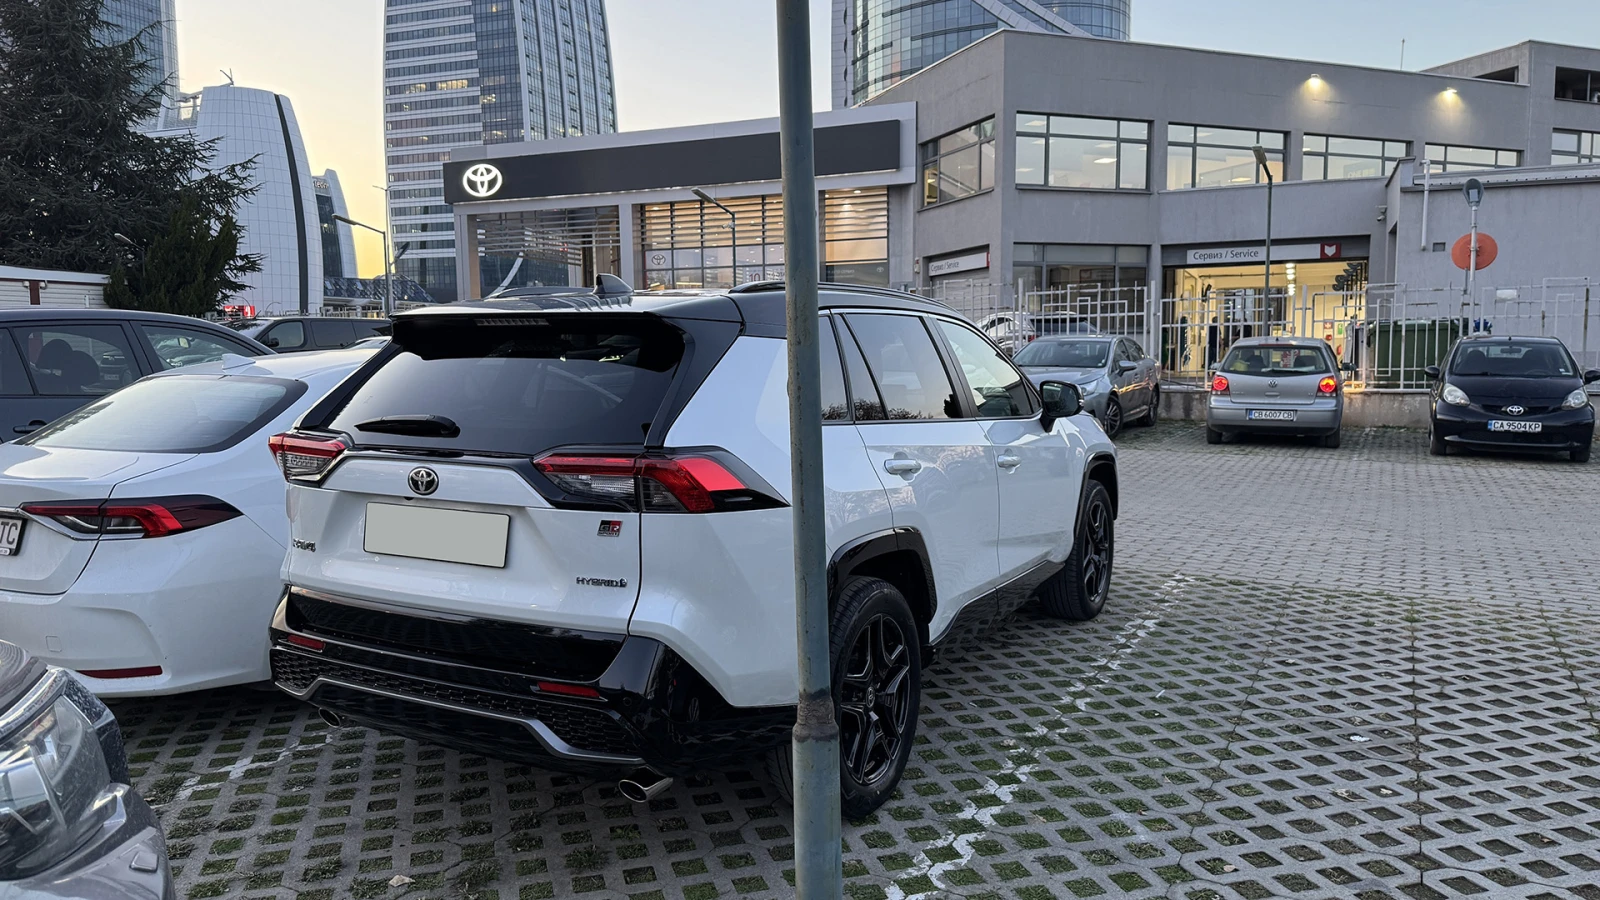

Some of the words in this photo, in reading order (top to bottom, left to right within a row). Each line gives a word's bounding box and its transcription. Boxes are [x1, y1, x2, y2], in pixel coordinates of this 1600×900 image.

[1193, 251, 1223, 261] Сервиз
[1230, 248, 1259, 259] Service
[948, 260, 960, 269] Service
[1264, 411, 1281, 419] 6007
[1493, 421, 1505, 430] CA
[1506, 422, 1527, 431] 9504
[1528, 423, 1541, 431] KP
[576, 577, 618, 588] HYBRID
